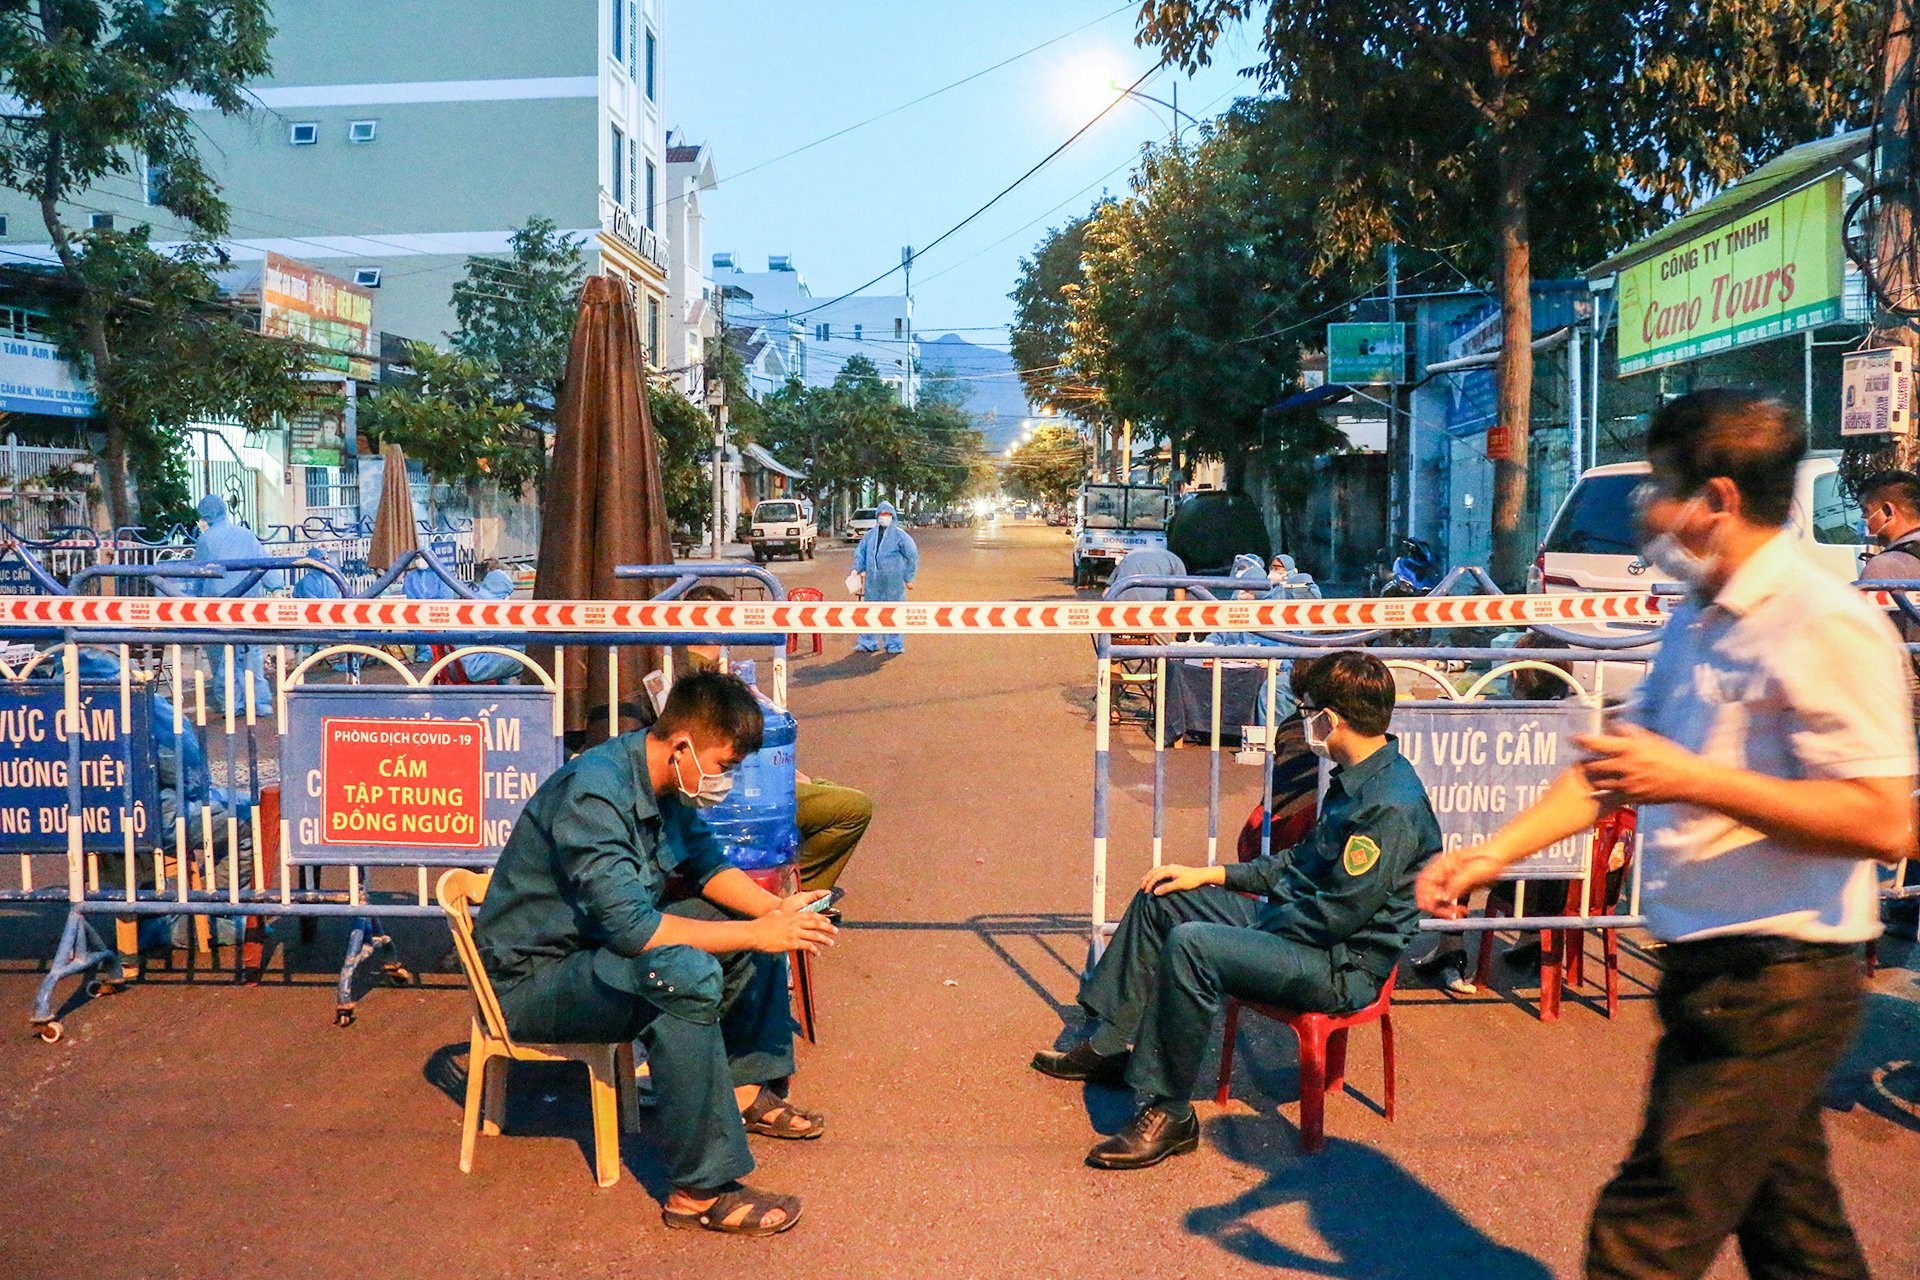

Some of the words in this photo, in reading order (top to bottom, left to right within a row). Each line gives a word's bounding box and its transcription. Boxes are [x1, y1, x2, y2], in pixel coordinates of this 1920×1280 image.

[1661, 248, 1698, 281] CÔNG
[1703, 239, 1722, 264] TY
[1725, 216, 1770, 256] TNHH
[1642, 296, 1702, 344] Cano
[1710, 262, 1797, 324] Tours
[1103, 537, 1147, 545] DONGBEN
[334, 730, 378, 745] PHÒNG
[380, 732, 411, 748] DỊCH
[412, 733, 451, 746] COVID
[459, 734, 472, 746] 19
[472, 704, 521, 752] ẤM
[1431, 727, 1488, 772] VỰC
[1495, 721, 1557, 766] CẤM
[0, 757, 68, 788] ƯƠNG
[379, 754, 427, 779] CẤM
[343, 782, 384, 809] TẬP
[388, 786, 464, 807] TRUNG
[1426, 781, 1506, 813] HƯƠNG
[39, 804, 111, 834] ĐƯNG
[332, 809, 397, 832] ĐÔNG
[401, 812, 475, 835] NGƯỜI
